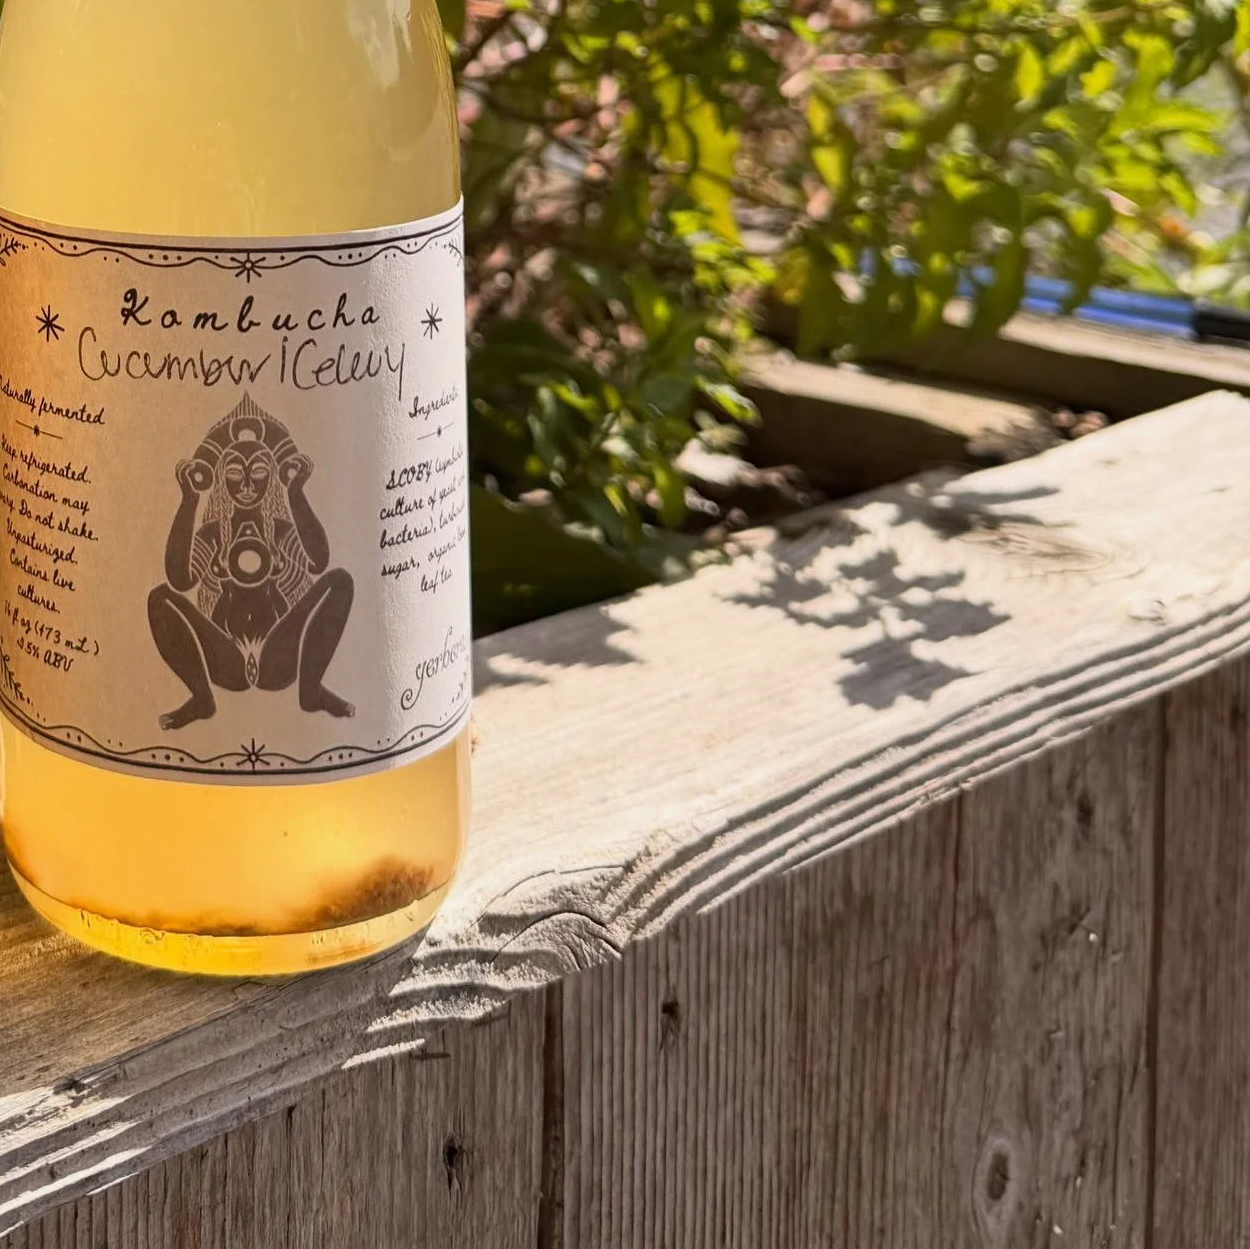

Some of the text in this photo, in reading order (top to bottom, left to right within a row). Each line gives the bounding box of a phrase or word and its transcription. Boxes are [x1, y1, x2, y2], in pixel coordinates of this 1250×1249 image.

[38, 397, 106, 425] fermented
[20, 451, 92, 484] refrigerated.
[386, 459, 432, 490] SCOBY
[2, 463, 90, 517] Carbonation may
[380, 495, 424, 521] culture
[428, 487, 437, 511] of
[19, 498, 32, 520] Do
[35, 512, 55, 530] not
[9, 548, 76, 592] Contains live
[381, 556, 420, 581] sugar,
[420, 570, 439, 594] leaf
[21, 617, 32, 635] oz
[43, 649, 75, 673] ABV
